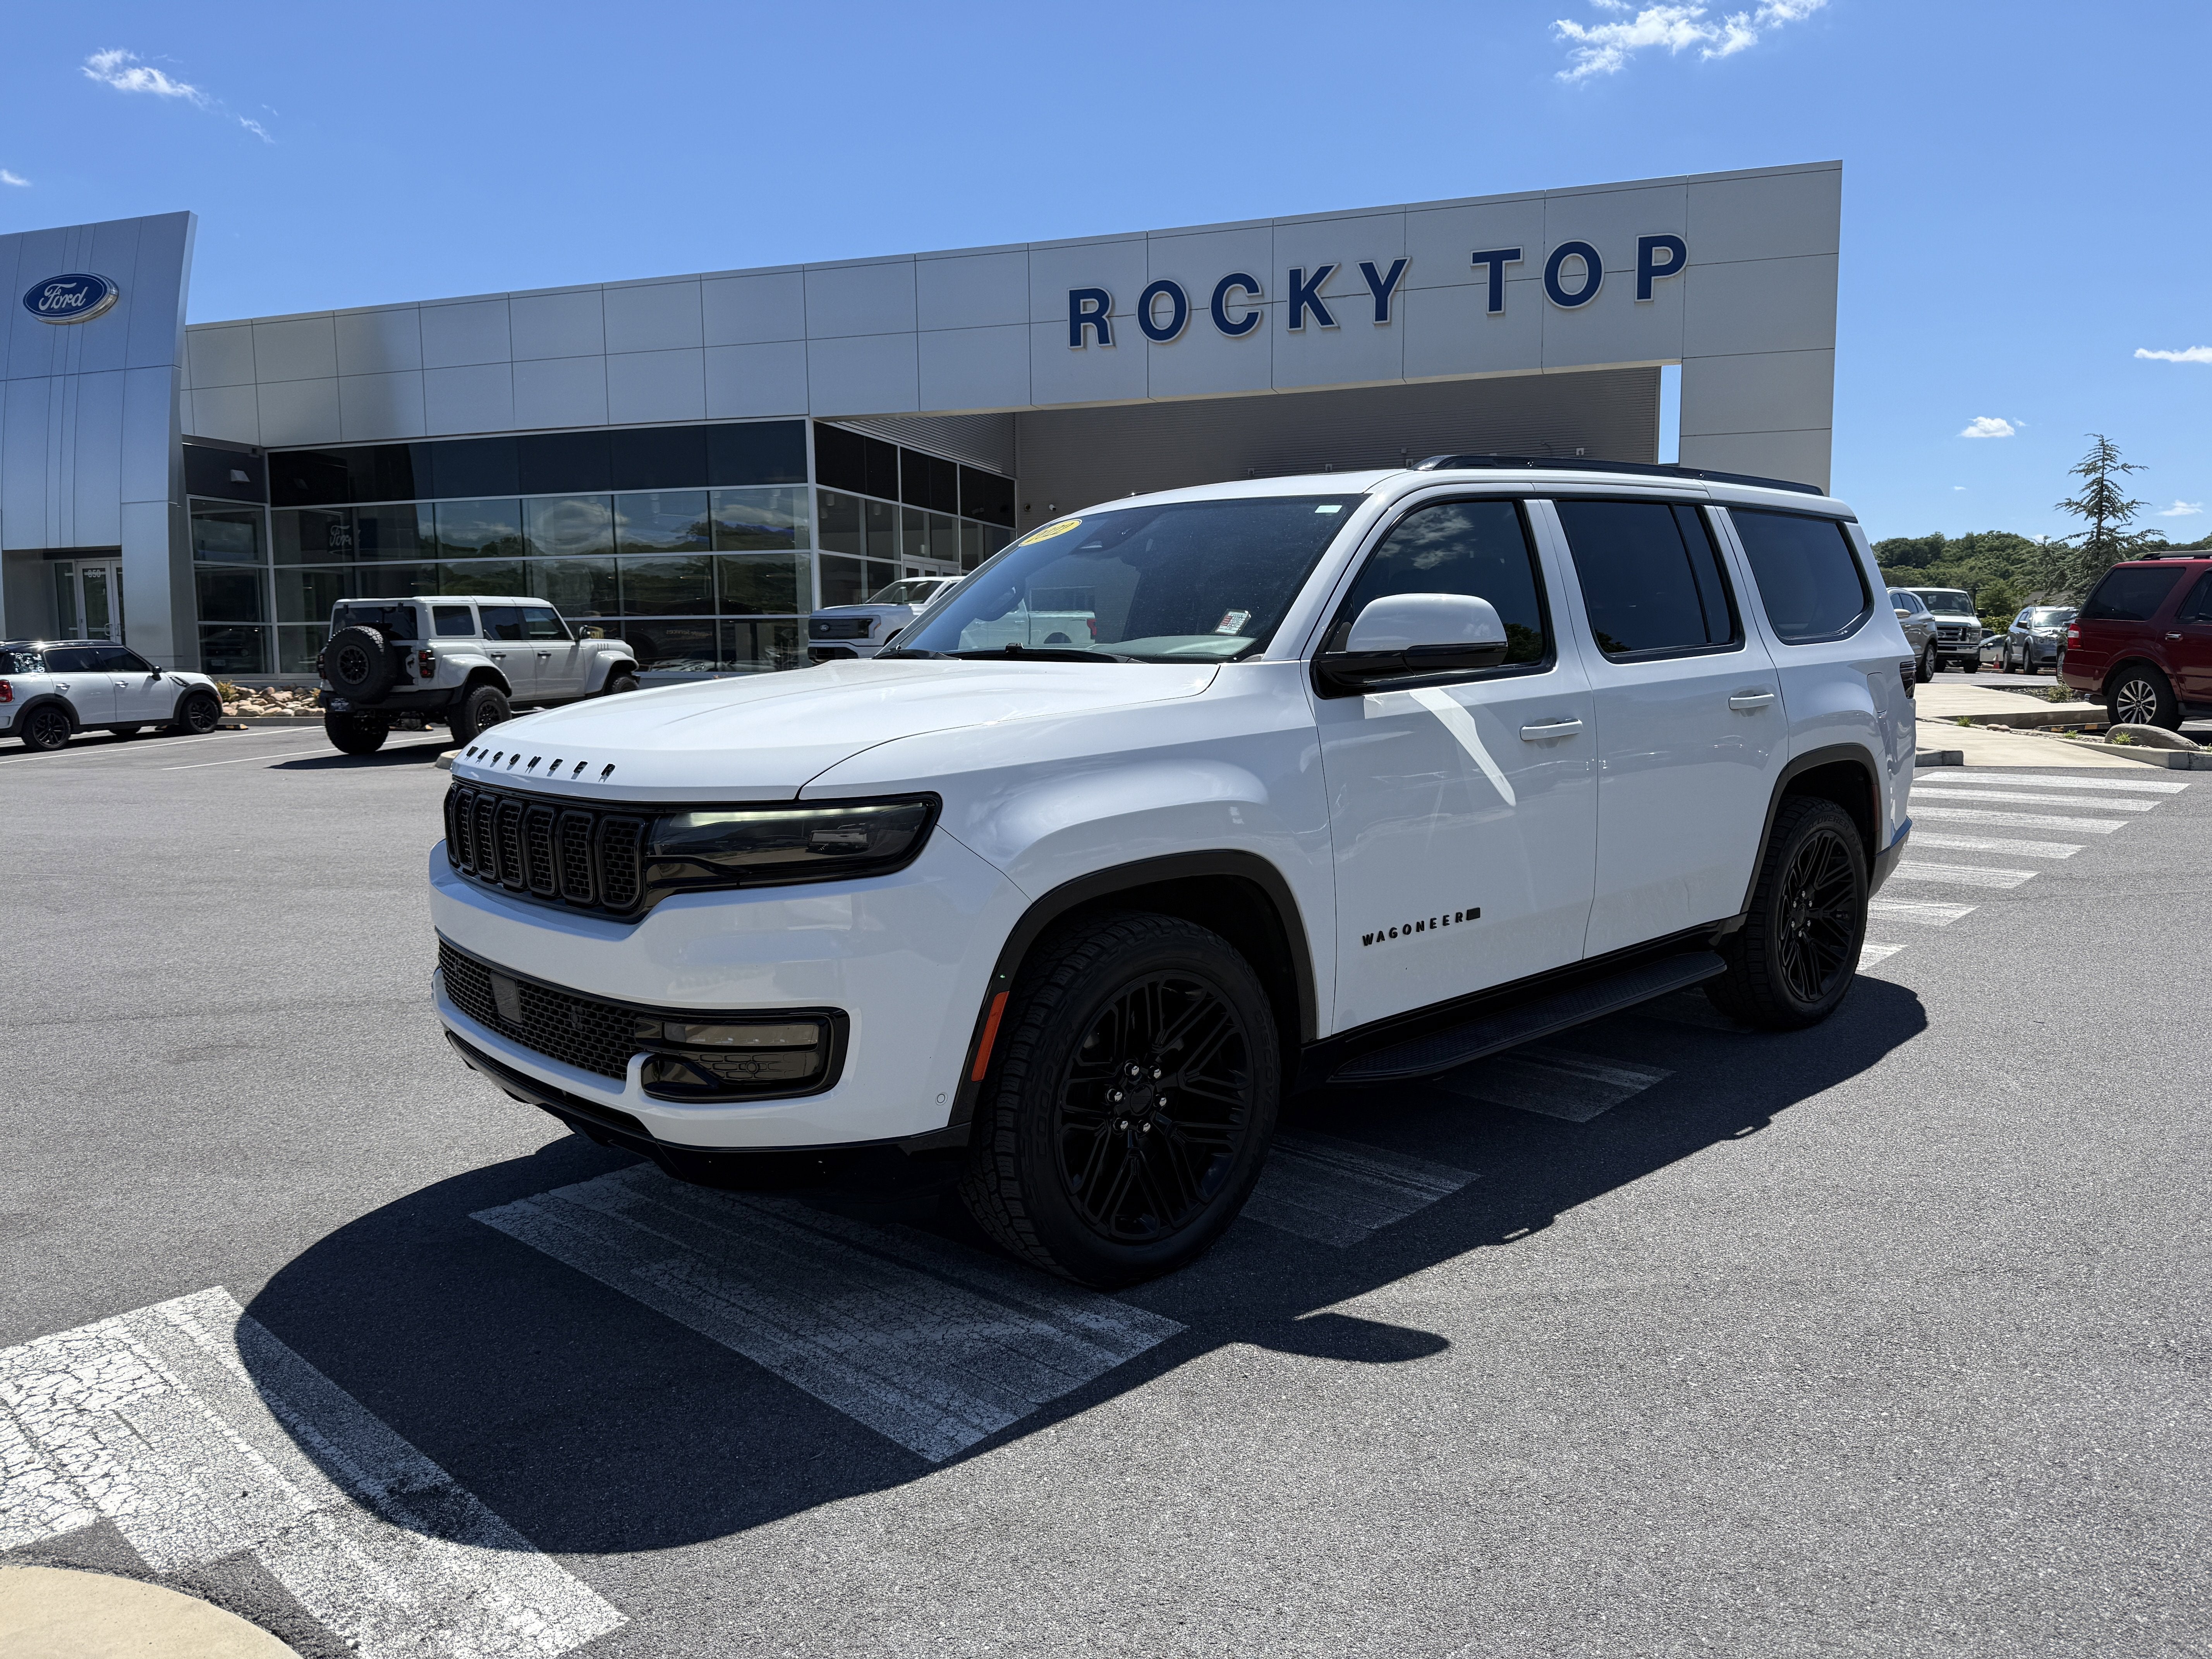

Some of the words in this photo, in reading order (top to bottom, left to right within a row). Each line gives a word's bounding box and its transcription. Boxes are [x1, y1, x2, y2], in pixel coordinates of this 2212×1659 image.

[39, 282, 88, 310] Ford
[1068, 257, 1411, 349] ROCKY
[1471, 232, 1688, 314] TOP
[466, 746, 615, 776] WAGONEER
[1362, 912, 1463, 946] WAGONEER
